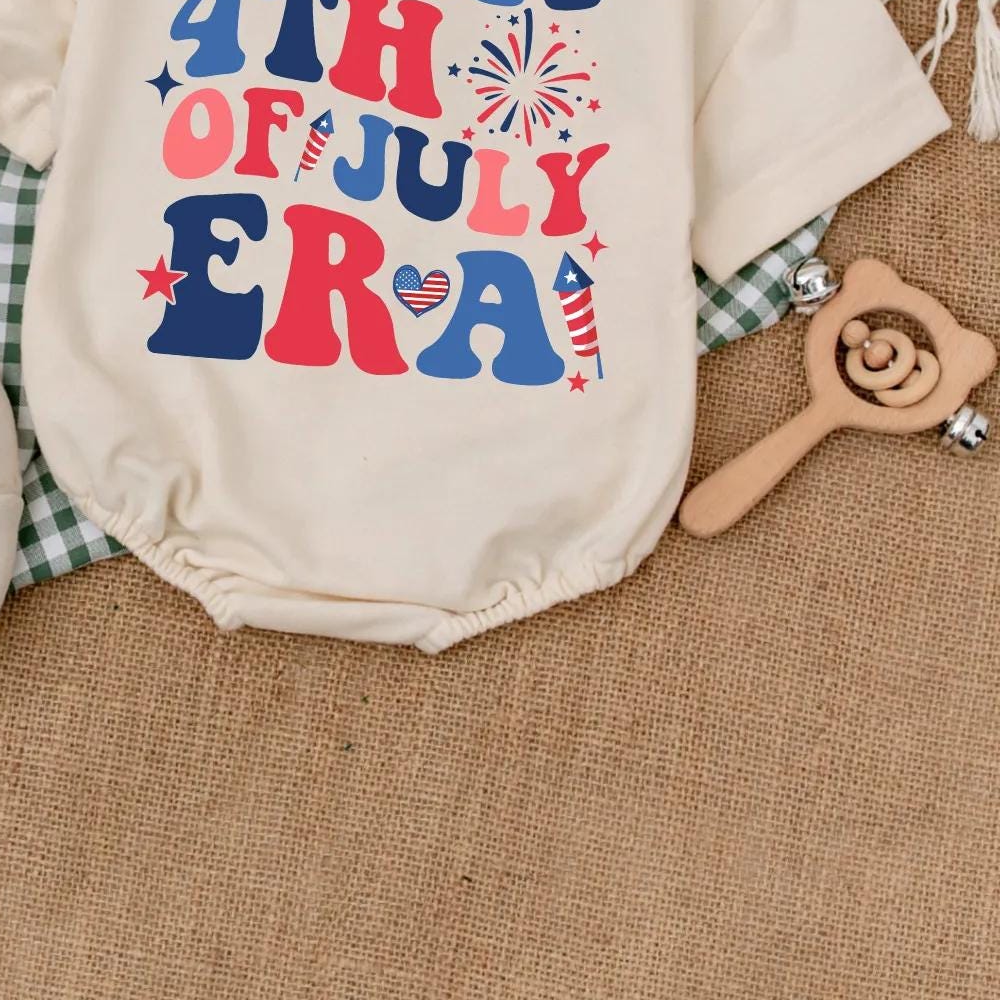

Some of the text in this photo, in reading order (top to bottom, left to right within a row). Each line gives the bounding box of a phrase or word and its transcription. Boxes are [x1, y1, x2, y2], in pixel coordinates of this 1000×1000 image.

[162, 87, 610, 237] OF JULY
[146, 193, 566, 386] ERA
